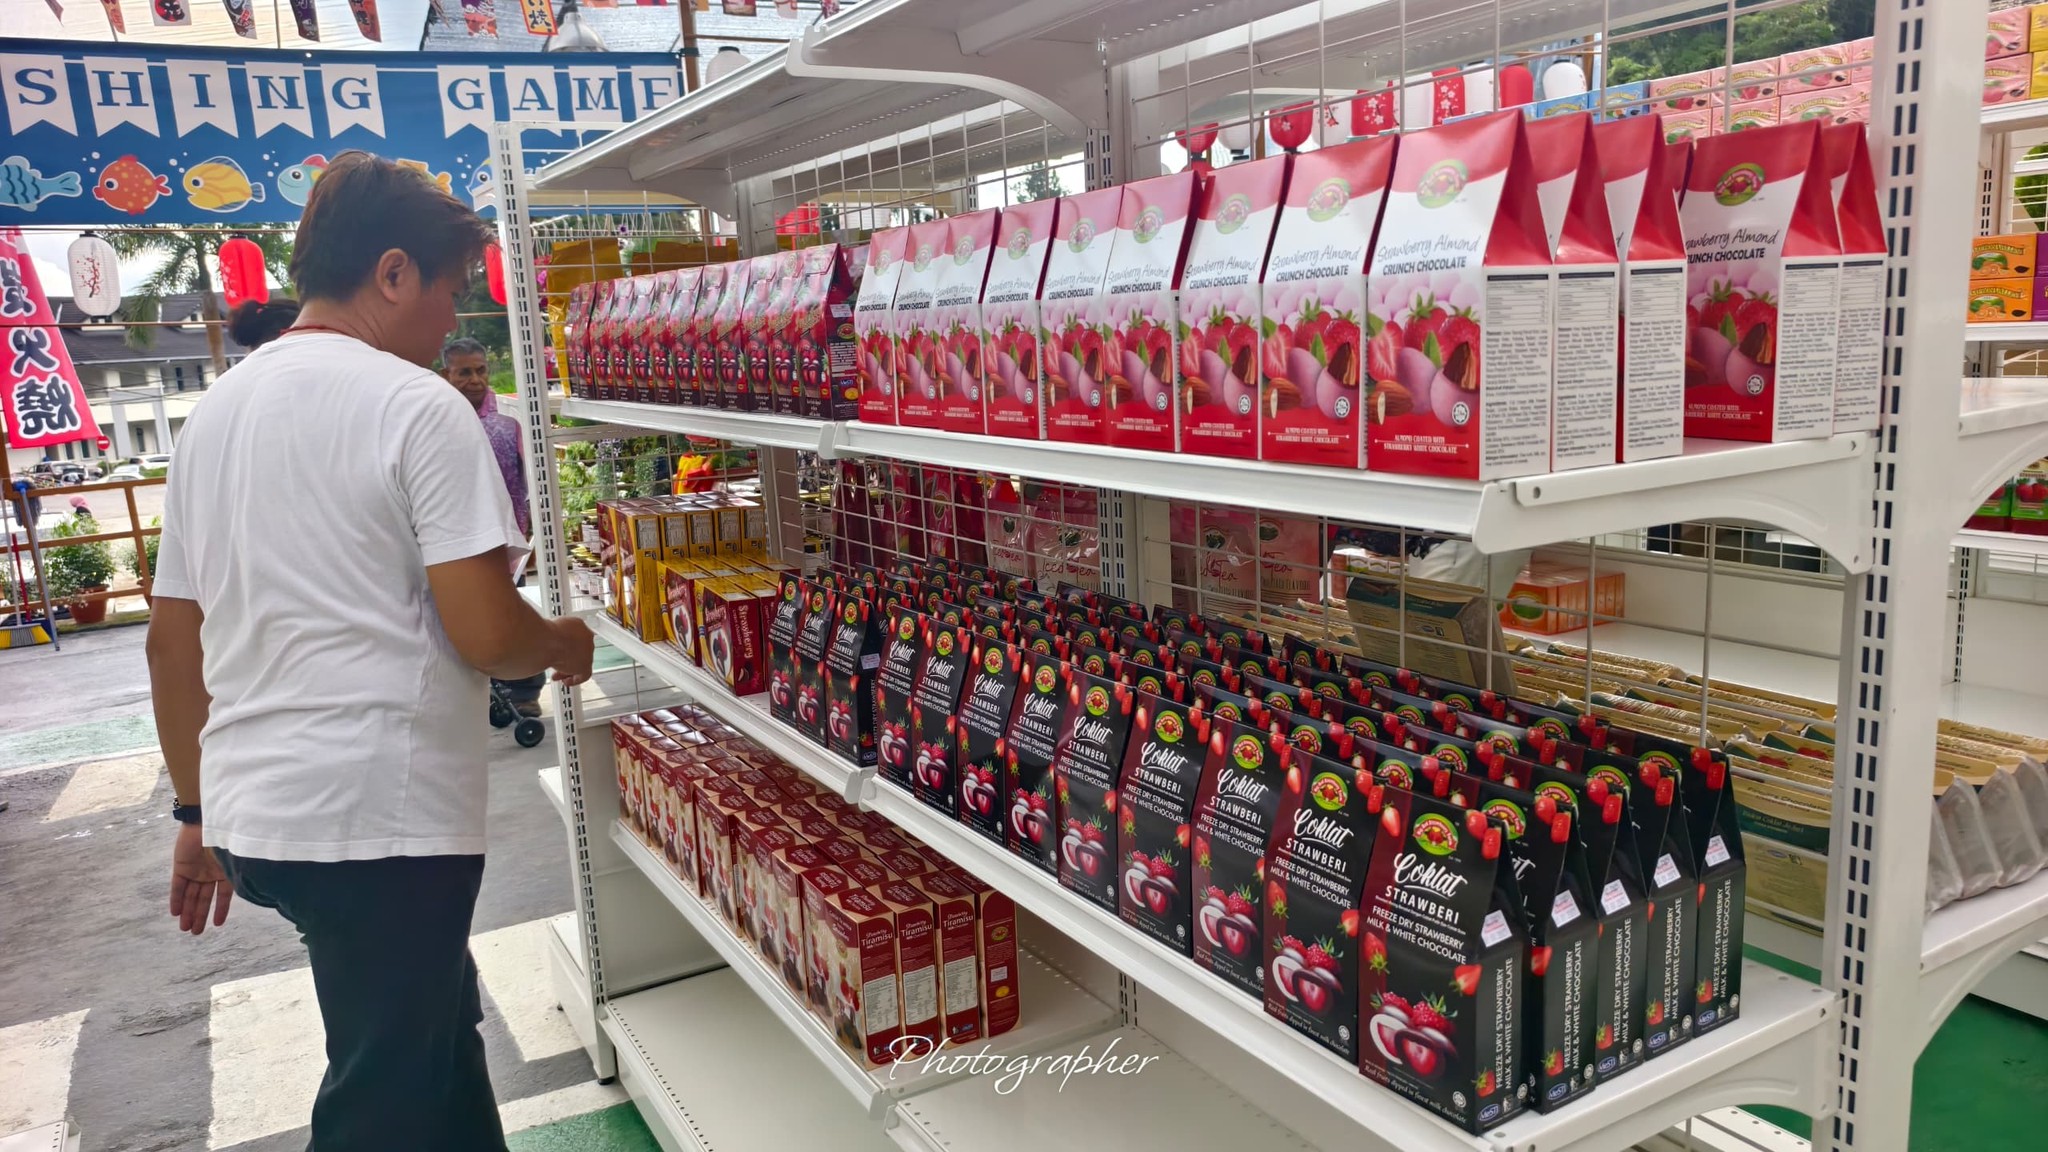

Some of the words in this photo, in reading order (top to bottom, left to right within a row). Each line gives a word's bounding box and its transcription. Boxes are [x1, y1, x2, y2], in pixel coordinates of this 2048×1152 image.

[1378, 239, 1431, 262] Strawberry
[1434, 234, 1481, 252] Almond
[1732, 228, 1779, 244] Almond
[1321, 245, 1361, 261] Almond
[1383, 263, 1415, 275] CRUNCH
[1417, 256, 1467, 272] CHOCOLATE
[1714, 247, 1765, 262] CHOCOLATE
[1190, 278, 1212, 289] CRUNCH
[1213, 274, 1248, 287] CHOCOLATE
[1276, 270, 1304, 282] CRUNCH
[1306, 265, 1349, 279] CHOCOLATE
[1111, 285, 1131, 295] CRUNCH
[1132, 282, 1161, 292] CHOCOLATE
[738, 604, 754, 659] Strawberry
[974, 674, 1005, 698] Coklat
[1024, 693, 1058, 719] Coklat
[1019, 716, 1053, 736] STRAWBERI
[1074, 716, 1113, 744] Coklat
[1068, 740, 1107, 763] STRAWBERI
[1141, 742, 1188, 774] Coklat
[1135, 767, 1180, 794] STRAWBERI
[1217, 769, 1269, 803] Coklat
[1210, 796, 1261, 825] STRAWBERI
[1196, 823, 1209, 833] MILK
[1214, 830, 1230, 843] WHITE
[1231, 838, 1265, 858] CHOCOLATE
[1201, 813, 1218, 827] FREEZE
[1219, 821, 1230, 831] DRY
[1230, 826, 1263, 845] STRAWBERRY
[1294, 808, 1354, 848] Coklat
[1286, 838, 1346, 872] STRAWBERI
[1270, 866, 1285, 878] MILK
[1292, 874, 1311, 890] WHITE
[1312, 883, 1351, 909] CHOCOLATE
[1275, 856, 1296, 872] FREEZE
[1296, 865, 1309, 877] DRY
[1310, 871, 1350, 896] STRAWBERRY
[1394, 853, 1468, 897] Coklat
[1385, 885, 1460, 924] STRAWBERI
[1723, 879, 1731, 936] CHOCOLATE
[901, 923, 932, 937] Tiramisu
[943, 915, 974, 928] Tiramisu
[1373, 905, 1397, 924] FREEZE
[1399, 915, 1413, 929] DRY
[1415, 922, 1464, 950] STRAWBERRY
[861, 932, 893, 946] Tiramisu
[1367, 916, 1384, 930] MILK
[1392, 926, 1416, 944] WHITE
[1417, 934, 1466, 964] CHOCOLATE
[1565, 950, 1573, 1012] STRAWBERRY
[1622, 980, 1630, 1010] WHITE
[1496, 968, 1504, 1028] STRAWBERRY
[1564, 1038, 1572, 1068] FREEZE
